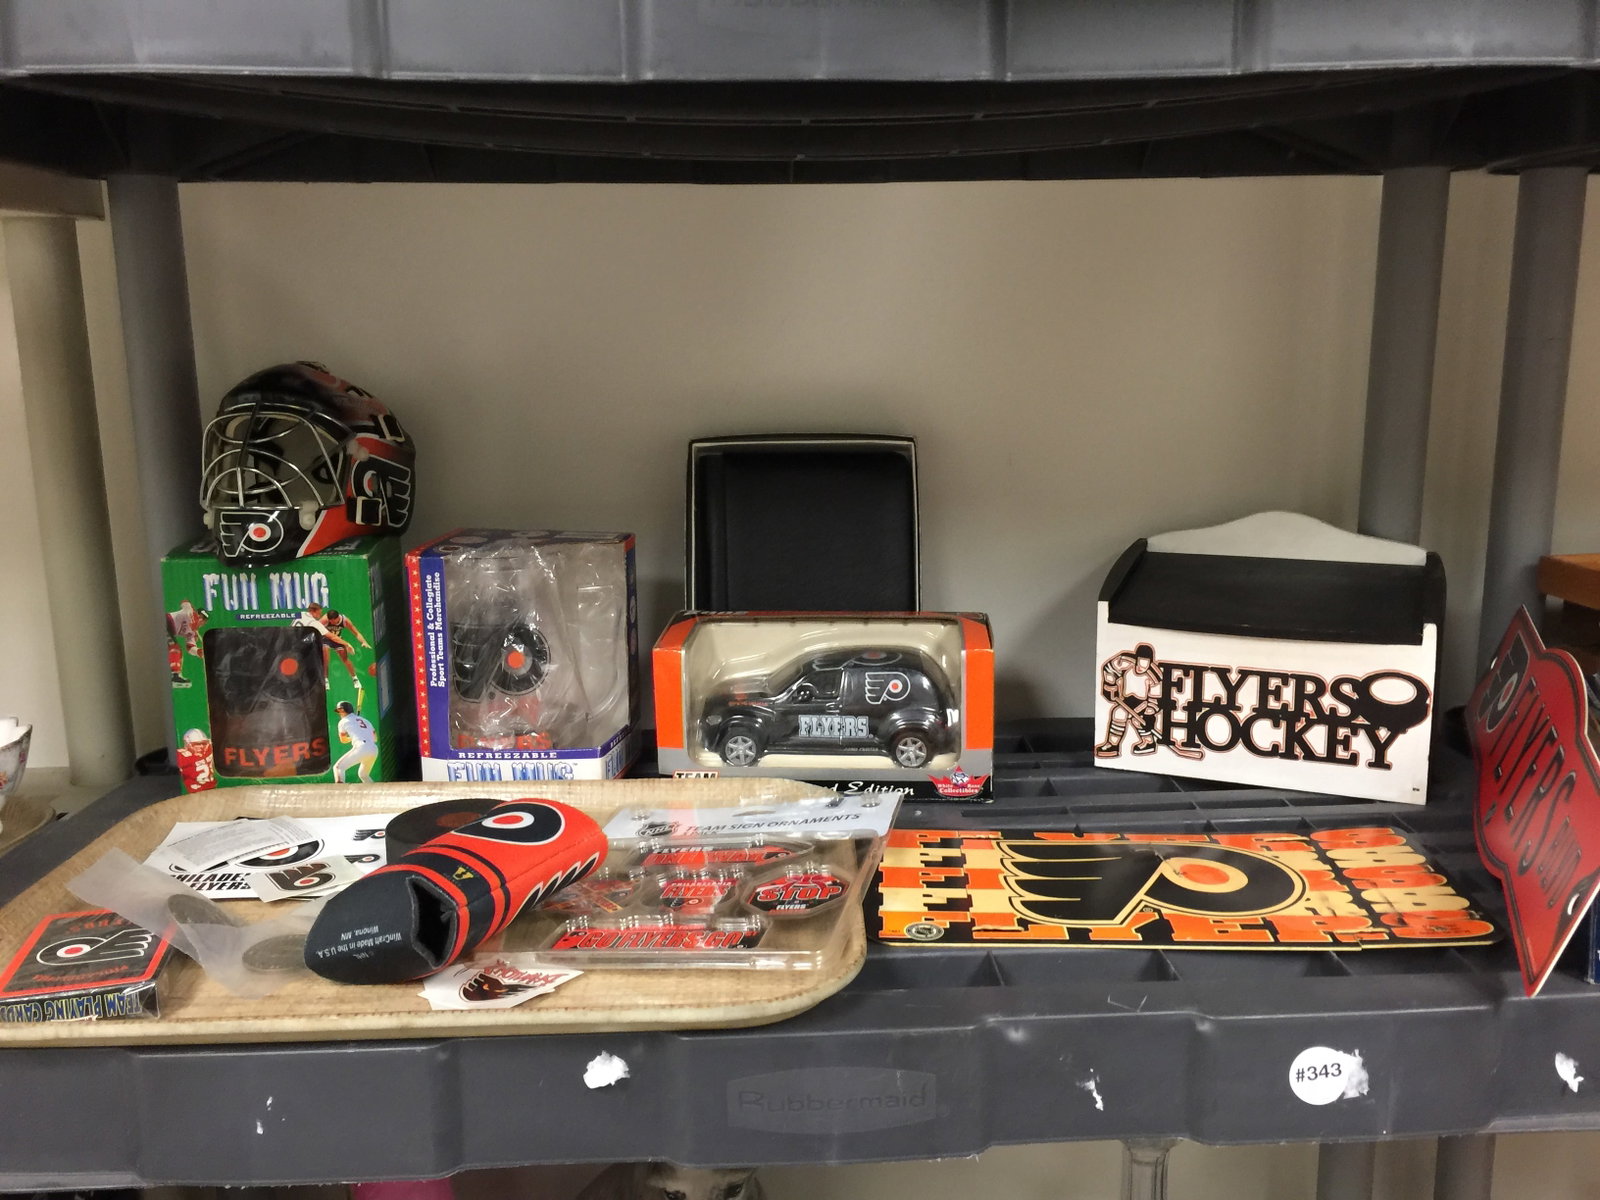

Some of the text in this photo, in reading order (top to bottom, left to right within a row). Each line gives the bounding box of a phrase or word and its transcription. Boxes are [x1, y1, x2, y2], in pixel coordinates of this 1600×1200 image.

[203, 572, 259, 611] FUN
[269, 571, 330, 610] MUG
[425, 574, 434, 621] Collegiate
[239, 612, 296, 620] REFREEZABLE
[434, 571, 446, 687] Sport Teams Merchandise
[427, 632, 438, 687] Professional
[1157, 661, 1362, 720] FLYERS
[799, 714, 870, 738] FLYERS
[1157, 700, 1394, 770] HOCKEY
[224, 737, 327, 768] FLYERS
[458, 752, 558, 760] REFREEZABLE
[847, 780, 915, 797] Edition
[686, 813, 863, 832] TEAM SIGN ORNAMENTS
[757, 885, 842, 902] STOP
[337, 944, 348, 953] the
[348, 942, 356, 951] in
[356, 937, 374, 948] Made
[374, 932, 402, 945] WinCraft
[577, 930, 620, 948] GO
[616, 930, 704, 948] FLYERS
[43, 994, 103, 1022] PLAYING
[104, 992, 143, 1018] TEAM
[1295, 1062, 1342, 1083] #343
[736, 1081, 928, 1113] Rubbermaid
